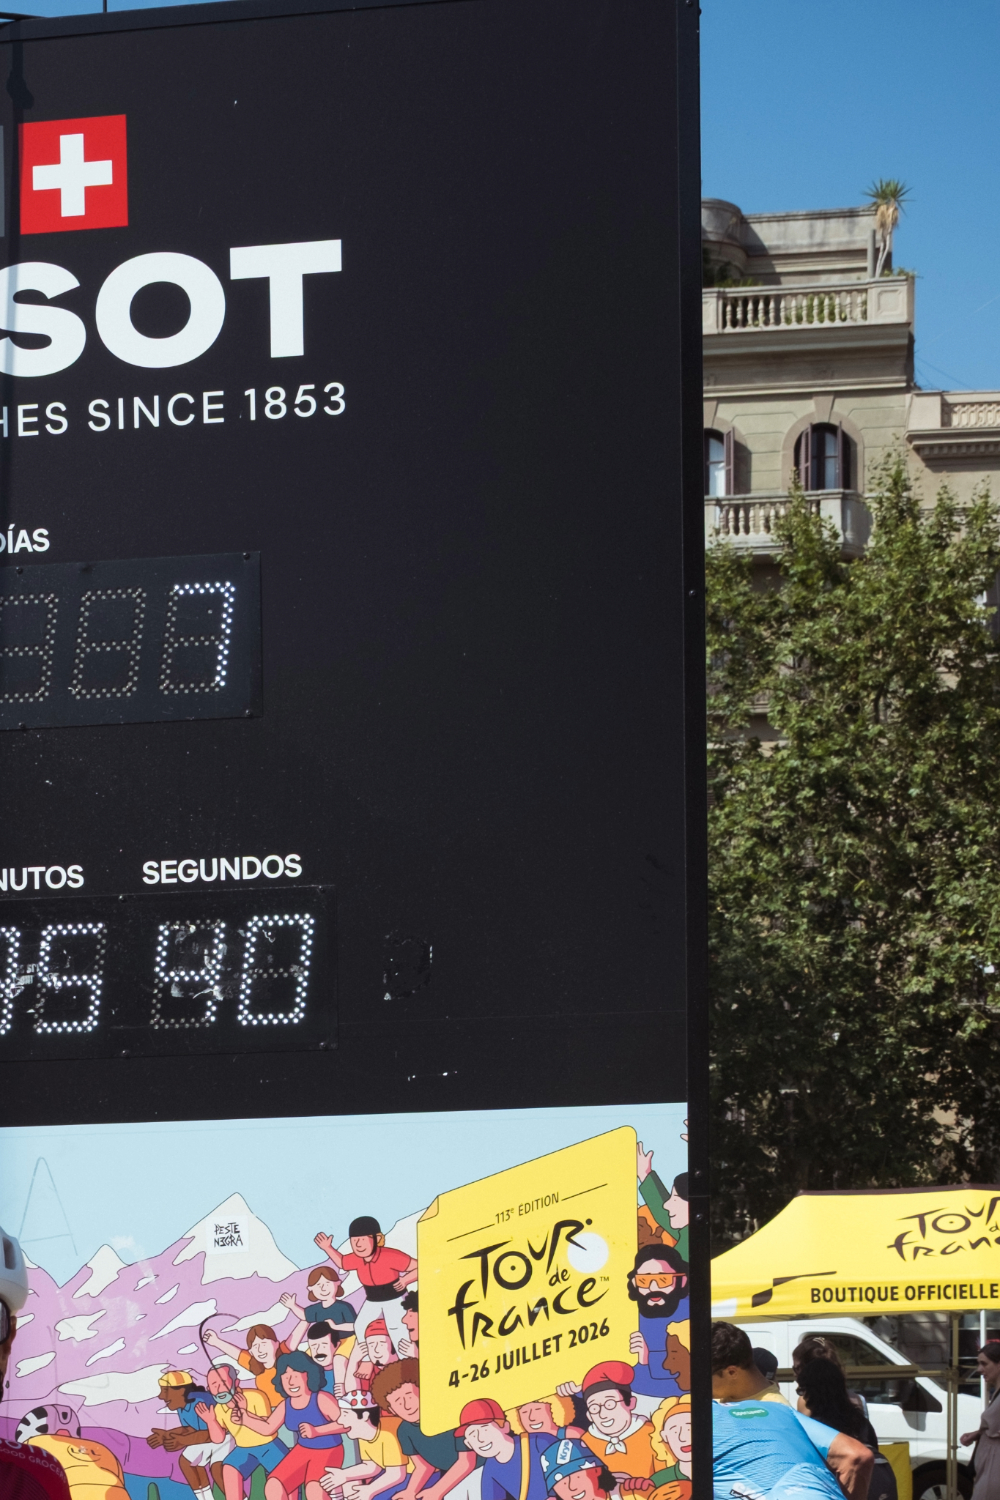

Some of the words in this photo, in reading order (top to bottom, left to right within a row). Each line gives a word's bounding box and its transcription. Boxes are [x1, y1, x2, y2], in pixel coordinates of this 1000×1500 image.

[87, 390, 225, 432] SINCE
[243, 381, 347, 422] 1853
[142, 853, 303, 886] SEGUNDOS
[518, 1191, 560, 1216] ÉDITION
[988, 1223, 1000, 1233] d
[458, 1217, 593, 1300] TOUR
[549, 1264, 571, 1288] de
[810, 1285, 899, 1304] BOUTIQUE
[905, 1283, 999, 1301] OFFICIELLE
[448, 1359, 490, 1388] 4-26
[494, 1334, 563, 1374] JUILLET
[568, 1317, 610, 1348] 2026
[559, 1440, 570, 1461] Krys
